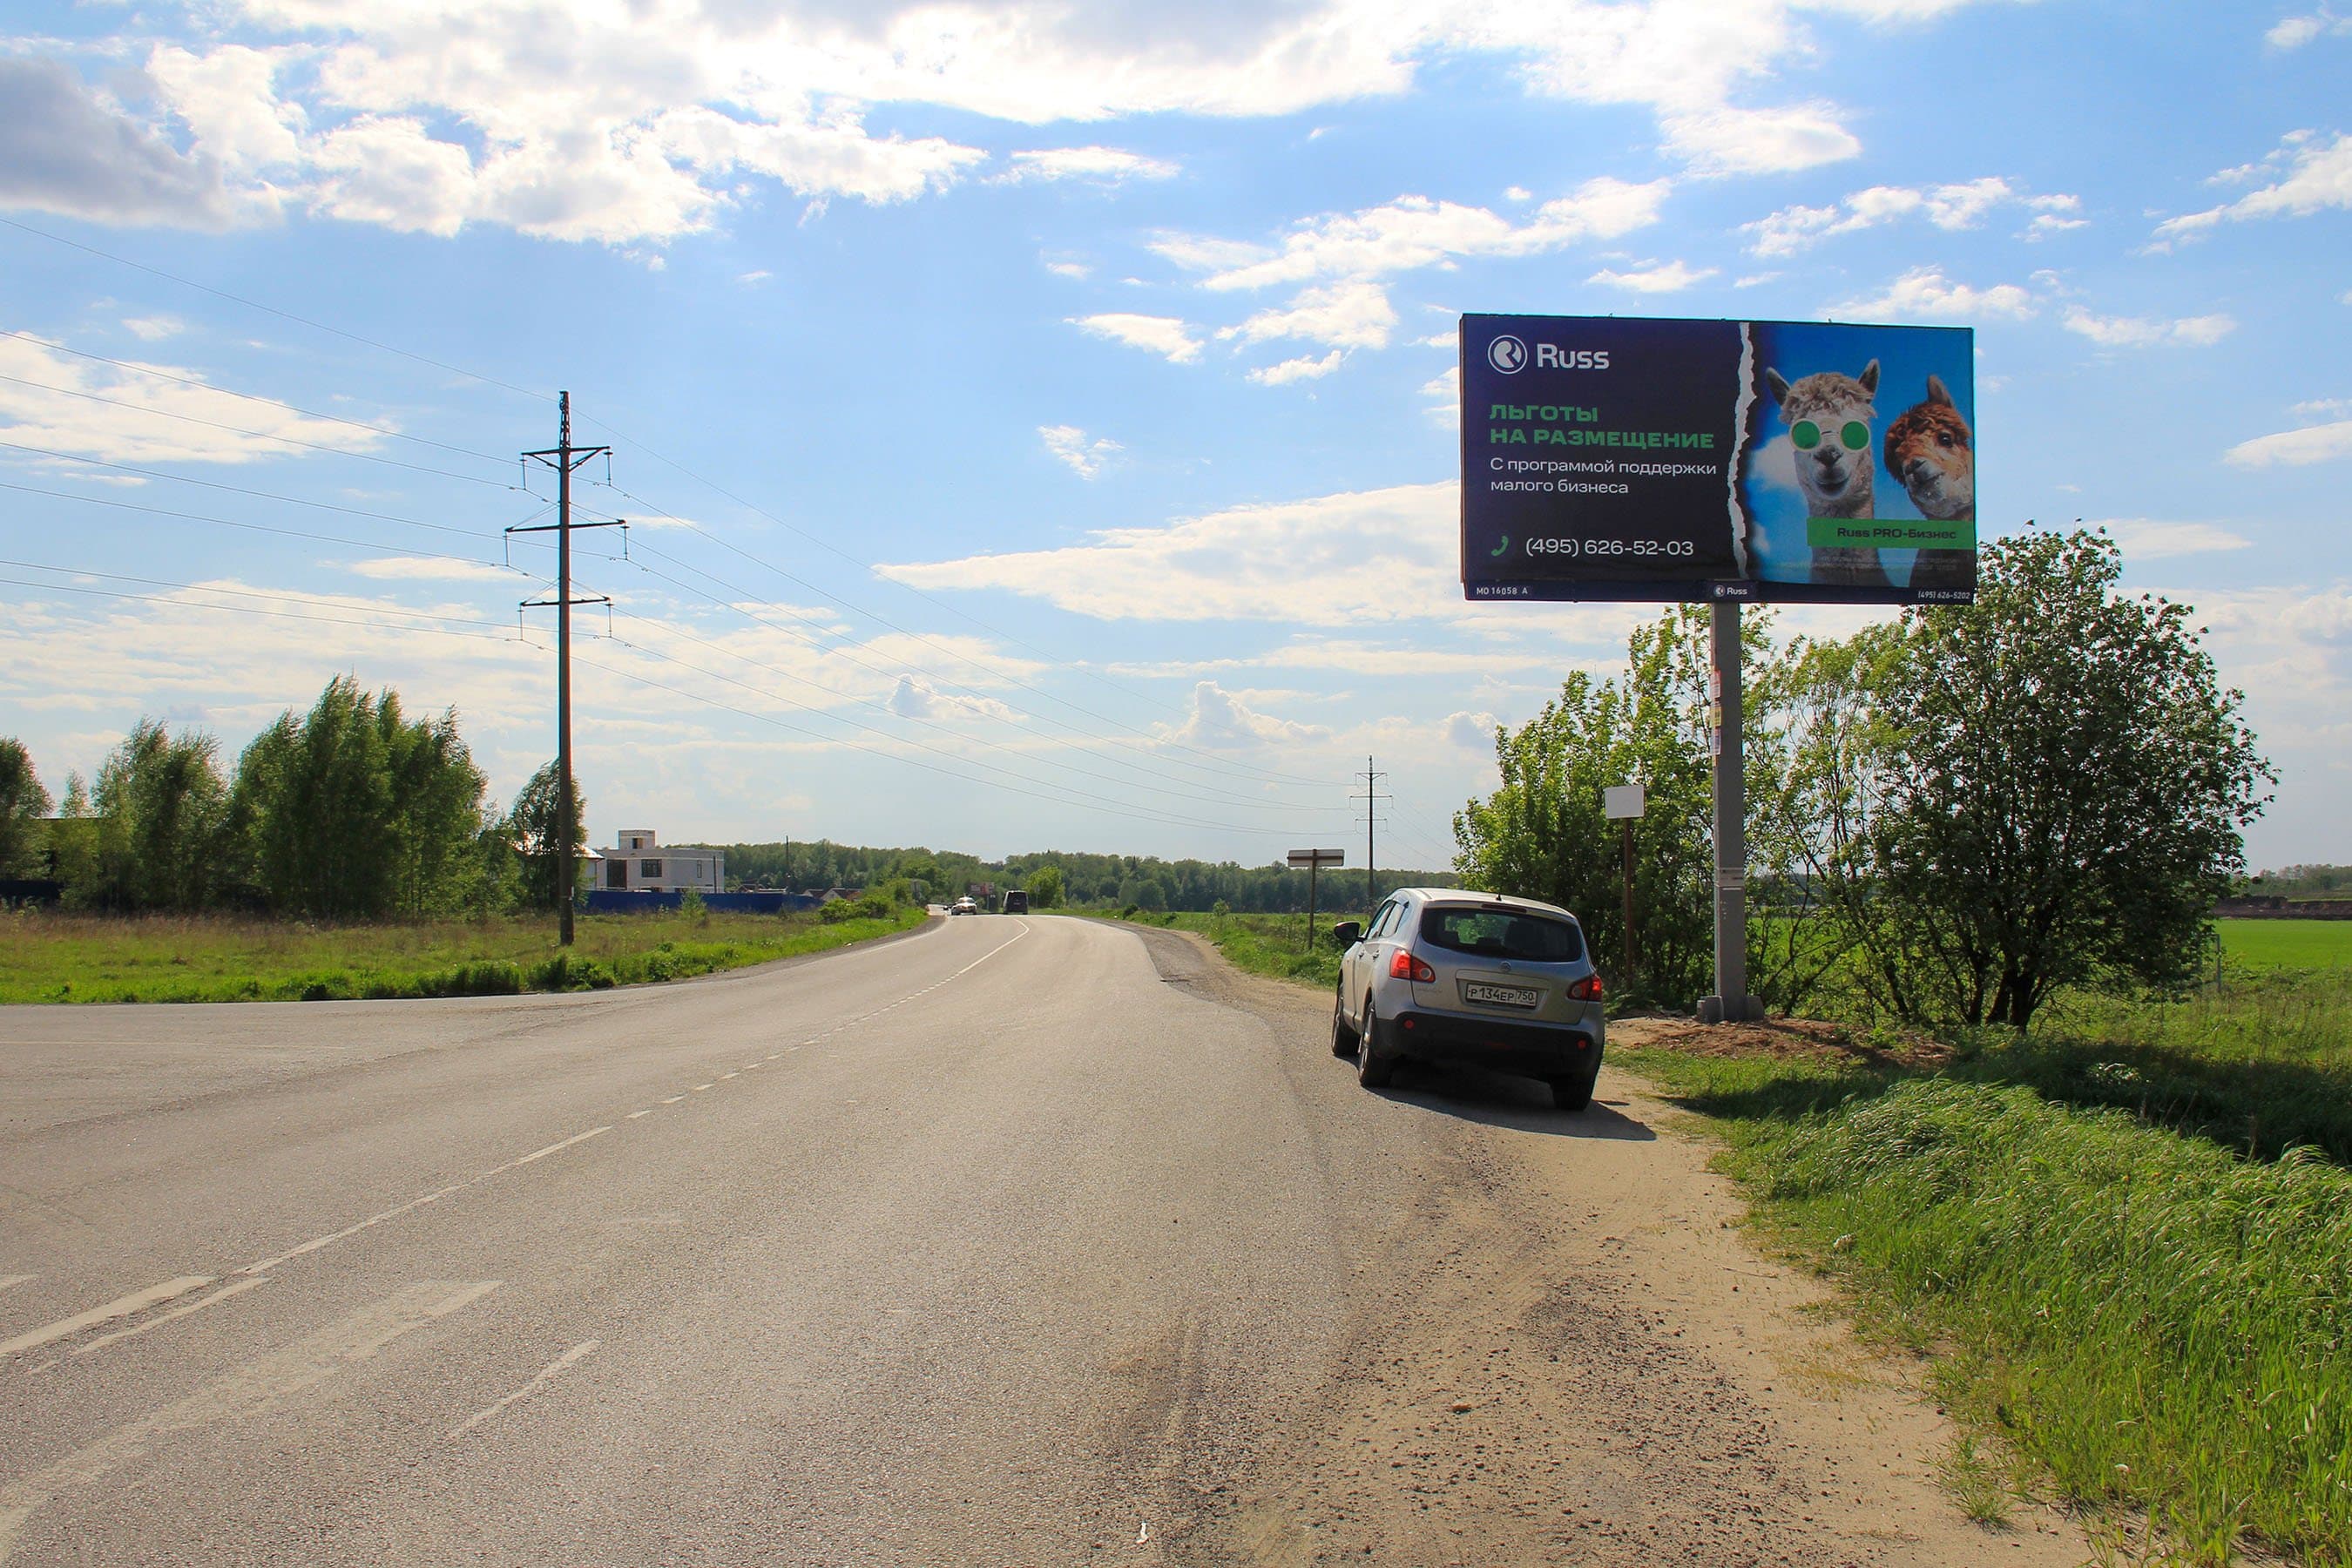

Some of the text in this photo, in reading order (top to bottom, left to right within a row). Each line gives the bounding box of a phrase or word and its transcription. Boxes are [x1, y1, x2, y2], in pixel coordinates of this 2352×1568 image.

[1537, 343, 1610, 369] Russ
[1490, 404, 1598, 422] ЛЬГОТЫ
[1490, 429, 1714, 449] НА РАЗМЕЩЕНИЕ
[1490, 457, 1717, 476] С программой поддержки
[1490, 479, 1629, 494] малого бизнеса
[1837, 527, 1957, 539] Russ PRO-Бизнес
[1525, 537, 1694, 558] (495) 626-52-03
[1491, 586, 1517, 595] 16058
[1727, 586, 1747, 595] Russ
[1917, 590, 1970, 599] (495) 626-5202
